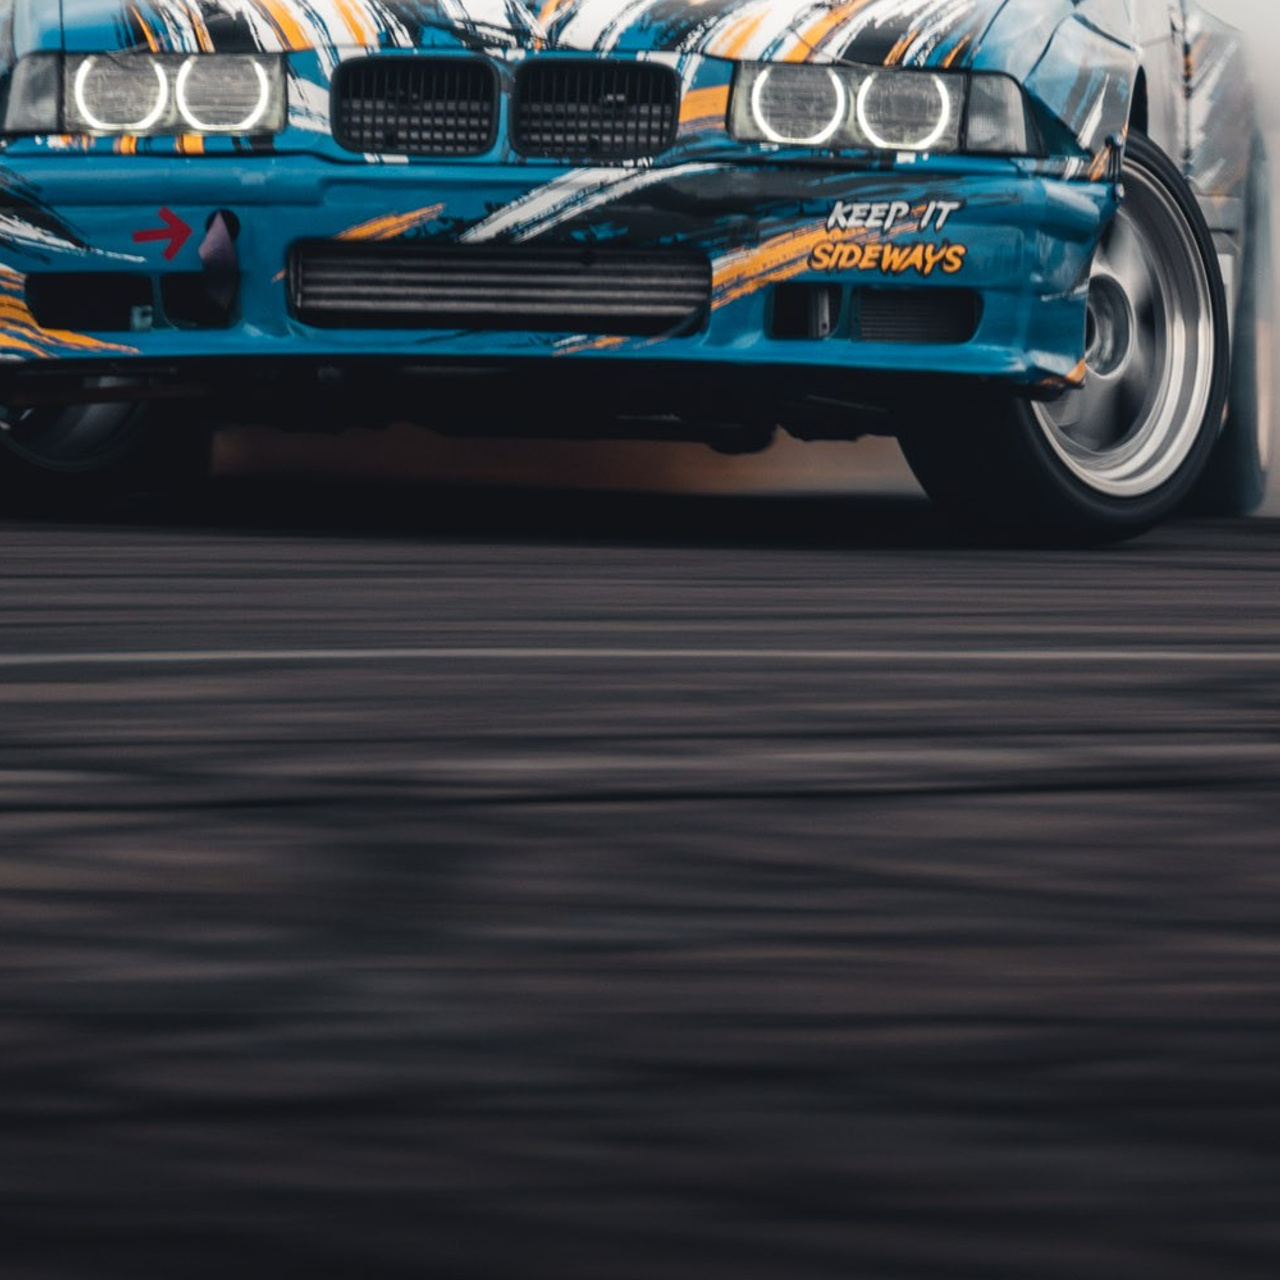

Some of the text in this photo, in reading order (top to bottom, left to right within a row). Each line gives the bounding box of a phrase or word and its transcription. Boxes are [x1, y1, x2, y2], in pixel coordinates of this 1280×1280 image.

[826, 200, 962, 232] KEEP IT
[810, 240, 967, 276] SIDEWAYS
